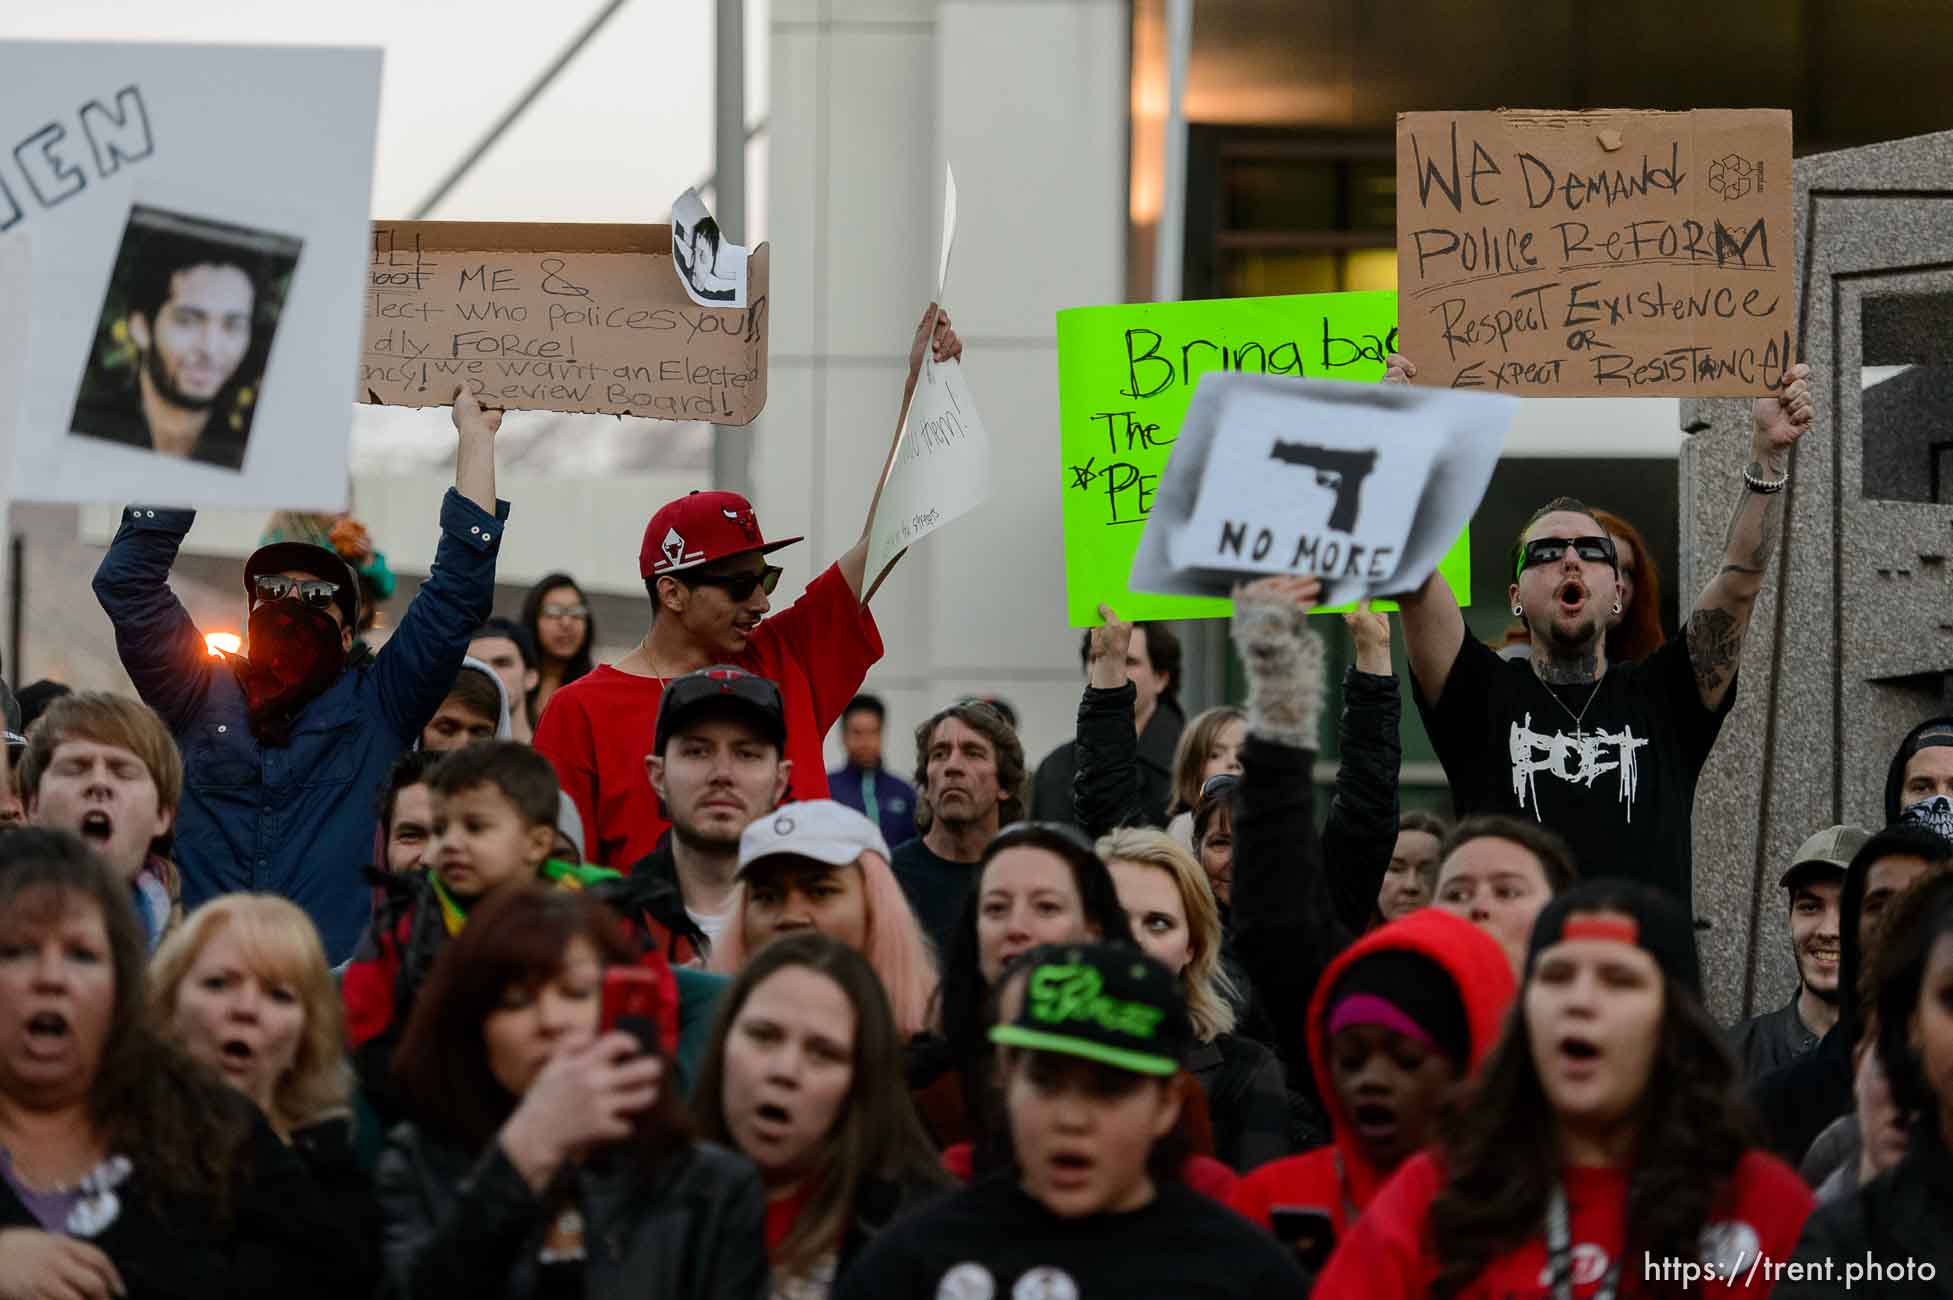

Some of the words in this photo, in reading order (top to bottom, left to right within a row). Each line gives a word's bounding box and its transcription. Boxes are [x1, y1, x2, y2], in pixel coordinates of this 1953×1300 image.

[458, 264, 521, 292] ME
[540, 258, 596, 303] &
[362, 291, 444, 322] lect
[373, 328, 430, 366] dly
[1566, 329, 1616, 351] OR
[612, 365, 652, 384] an
[1119, 328, 1304, 399] Bring
[1090, 411, 1177, 454] The
[1218, 519, 1275, 562] NO
[1291, 531, 1396, 578] MORE
